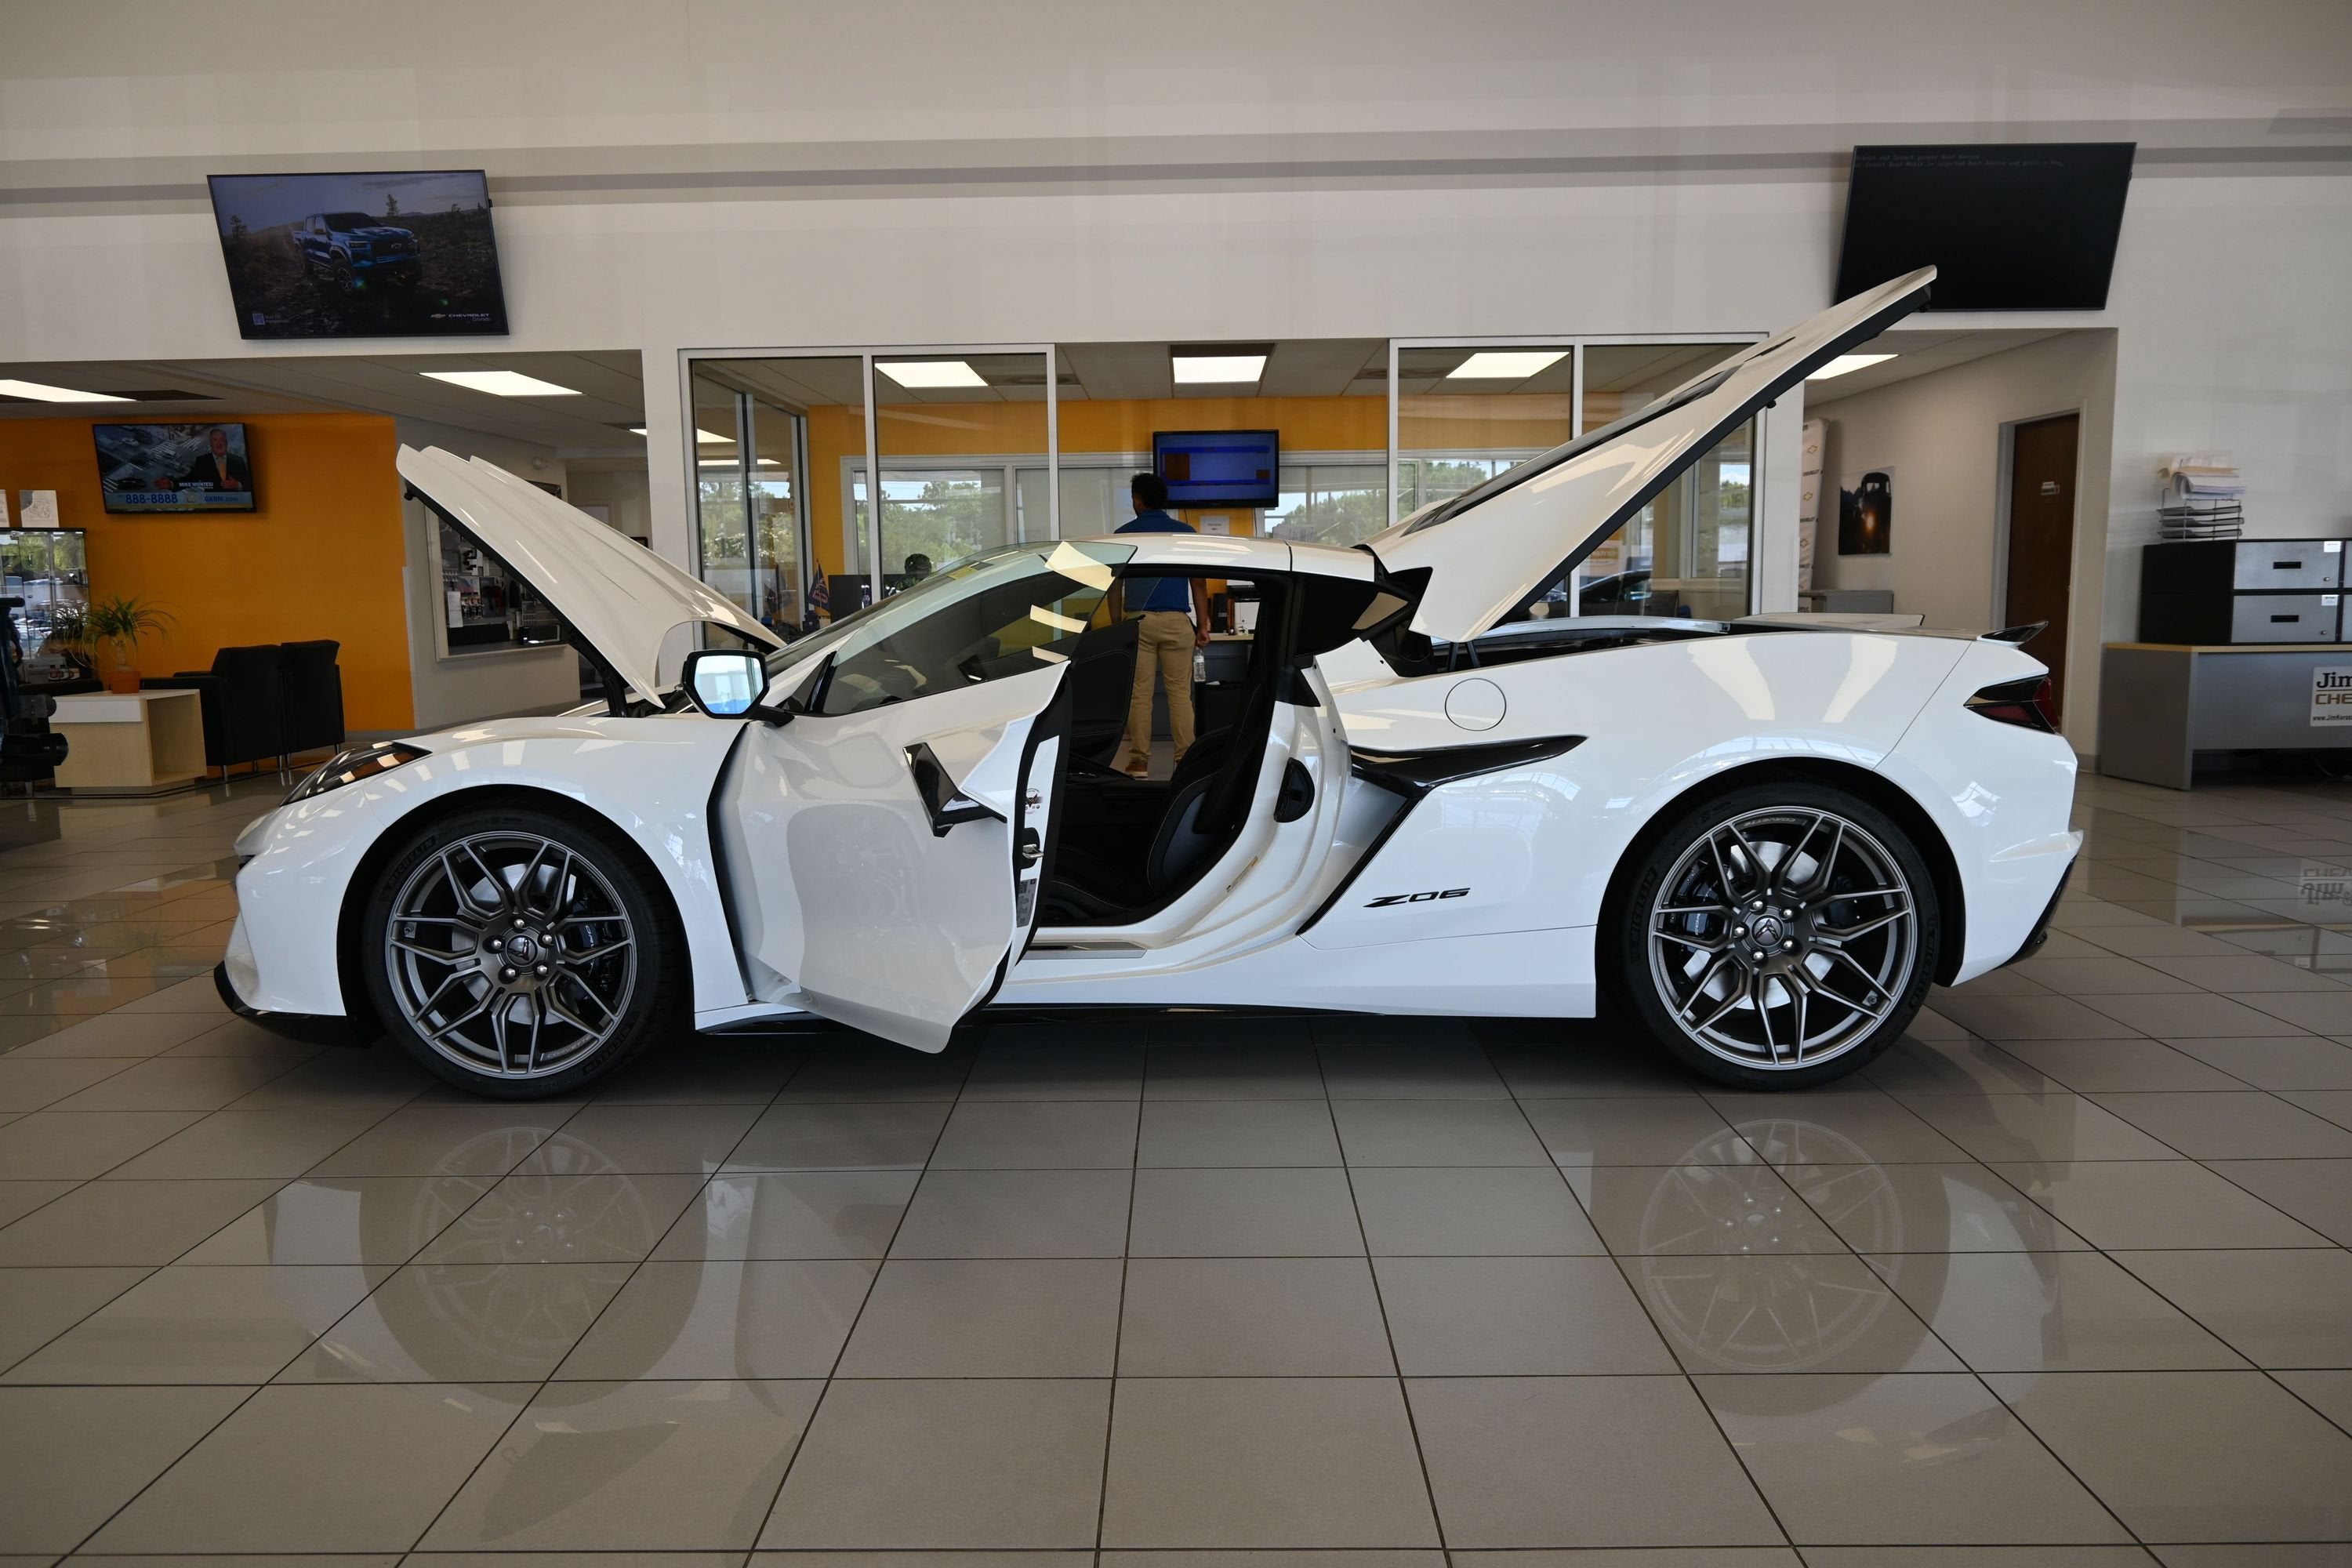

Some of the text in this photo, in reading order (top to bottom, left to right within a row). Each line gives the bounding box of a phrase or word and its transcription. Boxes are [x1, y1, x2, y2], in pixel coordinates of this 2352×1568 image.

[125, 493, 179, 504] 888-8888
[2316, 671, 2352, 688] Jim
[1744, 817, 1796, 827] CORVETTE
[387, 836, 436, 889] MICHELIN
[1363, 887, 1471, 908] Z06
[1630, 869, 1657, 943] MICHELIN
[1910, 935, 1935, 1008] MICHELIN
[546, 1033, 594, 1059] CORVETTE
[583, 1024, 633, 1075] MICHELIN
